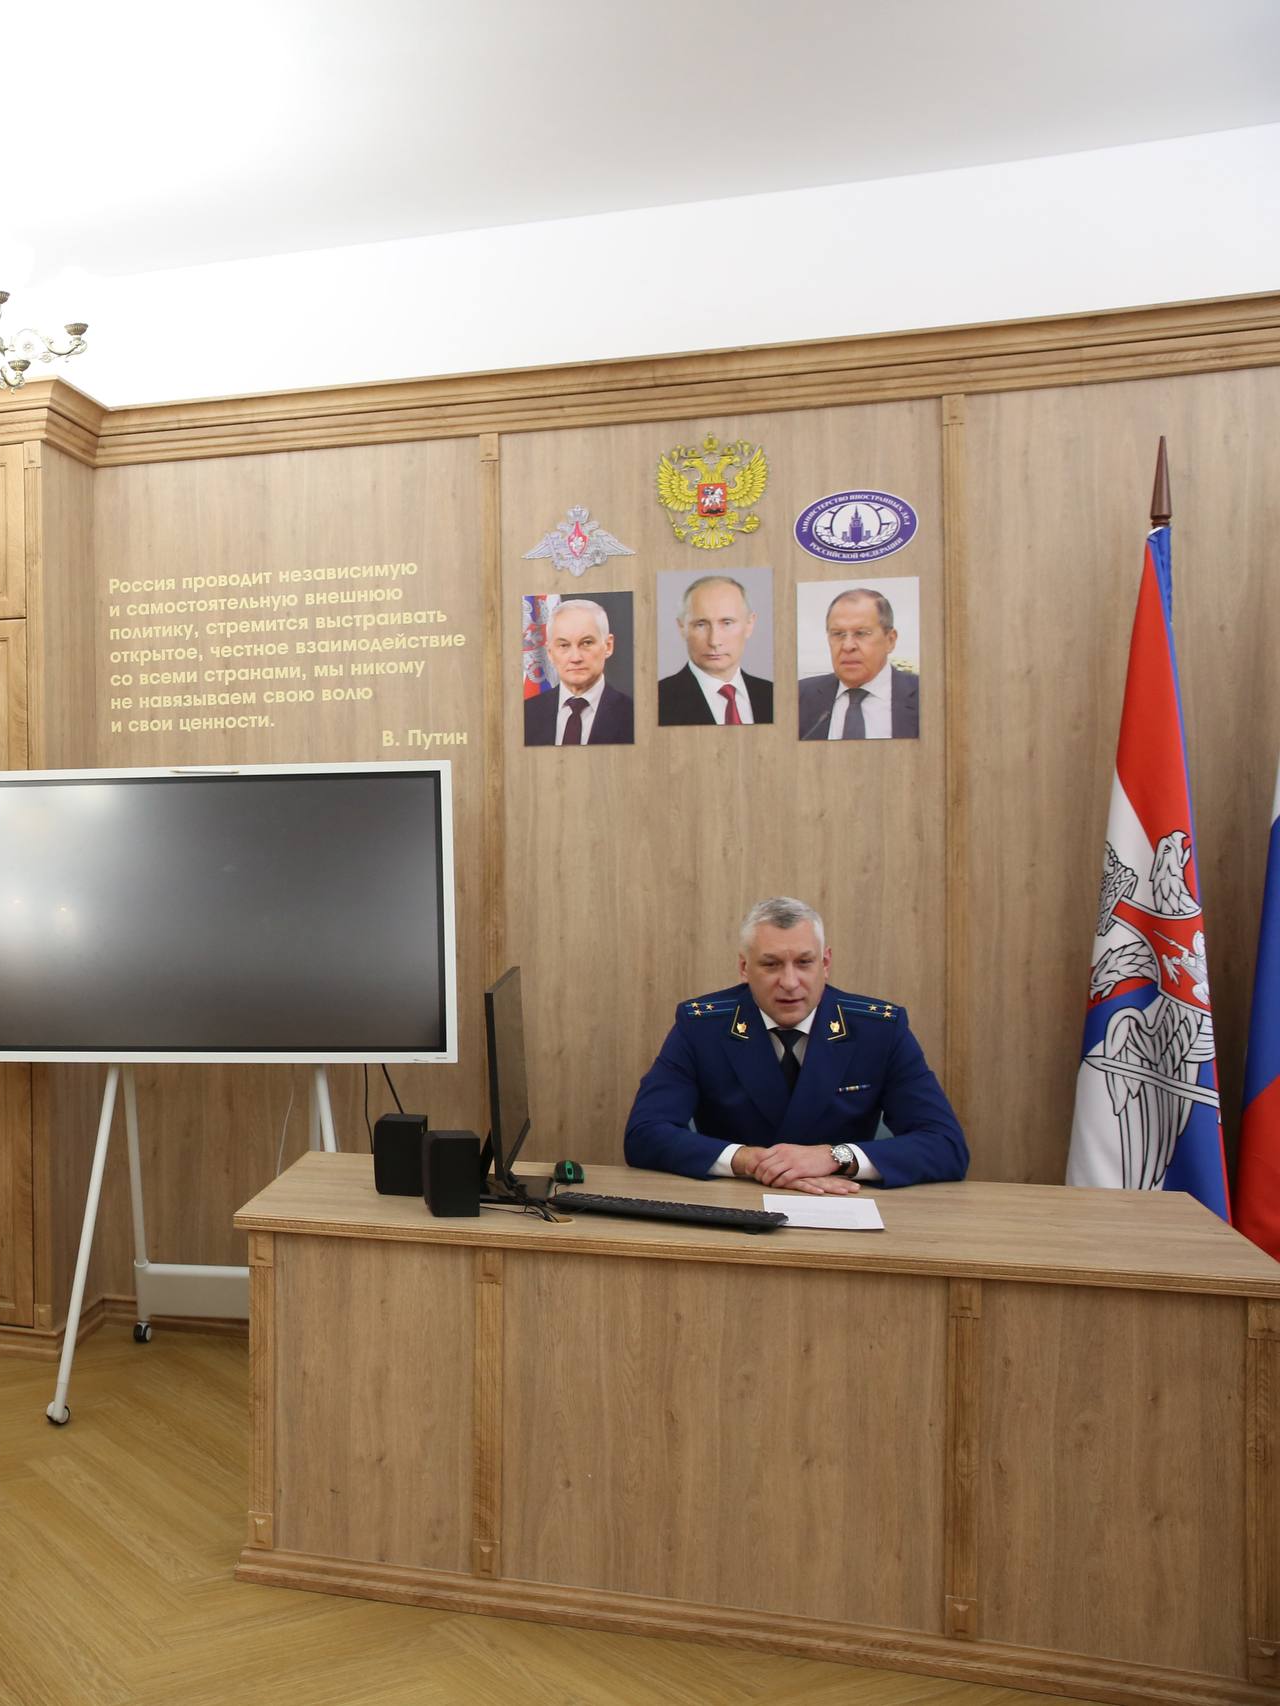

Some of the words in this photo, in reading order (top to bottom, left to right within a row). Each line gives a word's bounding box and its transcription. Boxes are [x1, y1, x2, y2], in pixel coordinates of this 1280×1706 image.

[802, 496, 848, 532] МИНИСТЕРСТВО
[810, 542, 858, 558] РОССИЙСКОЙ
[109, 578, 175, 594] Россия
[182, 571, 272, 592] проводит
[279, 562, 417, 583] независимую
[109, 605, 119, 617] и
[126, 594, 298, 616] самостоятельную
[305, 588, 403, 605] внешнюю
[110, 623, 198, 640] политику,
[206, 617, 308, 638] стремится
[315, 610, 447, 631] выстраивать
[110, 647, 203, 666] открытое,
[210, 642, 288, 658] честное
[296, 633, 465, 654] взаимодействие
[110, 674, 133, 686] со
[139, 671, 197, 685] всеми
[204, 666, 306, 685] странами,
[314, 664, 343, 677] мы
[351, 660, 425, 677] никому
[111, 697, 133, 709] не
[139, 692, 256, 708] навязываем
[263, 689, 314, 703] свою
[322, 687, 372, 701] волю
[111, 720, 121, 732] и
[128, 719, 172, 732] свои
[179, 715, 274, 732] ценности.
[382, 730, 400, 746] В.
[408, 729, 467, 750] Путин
